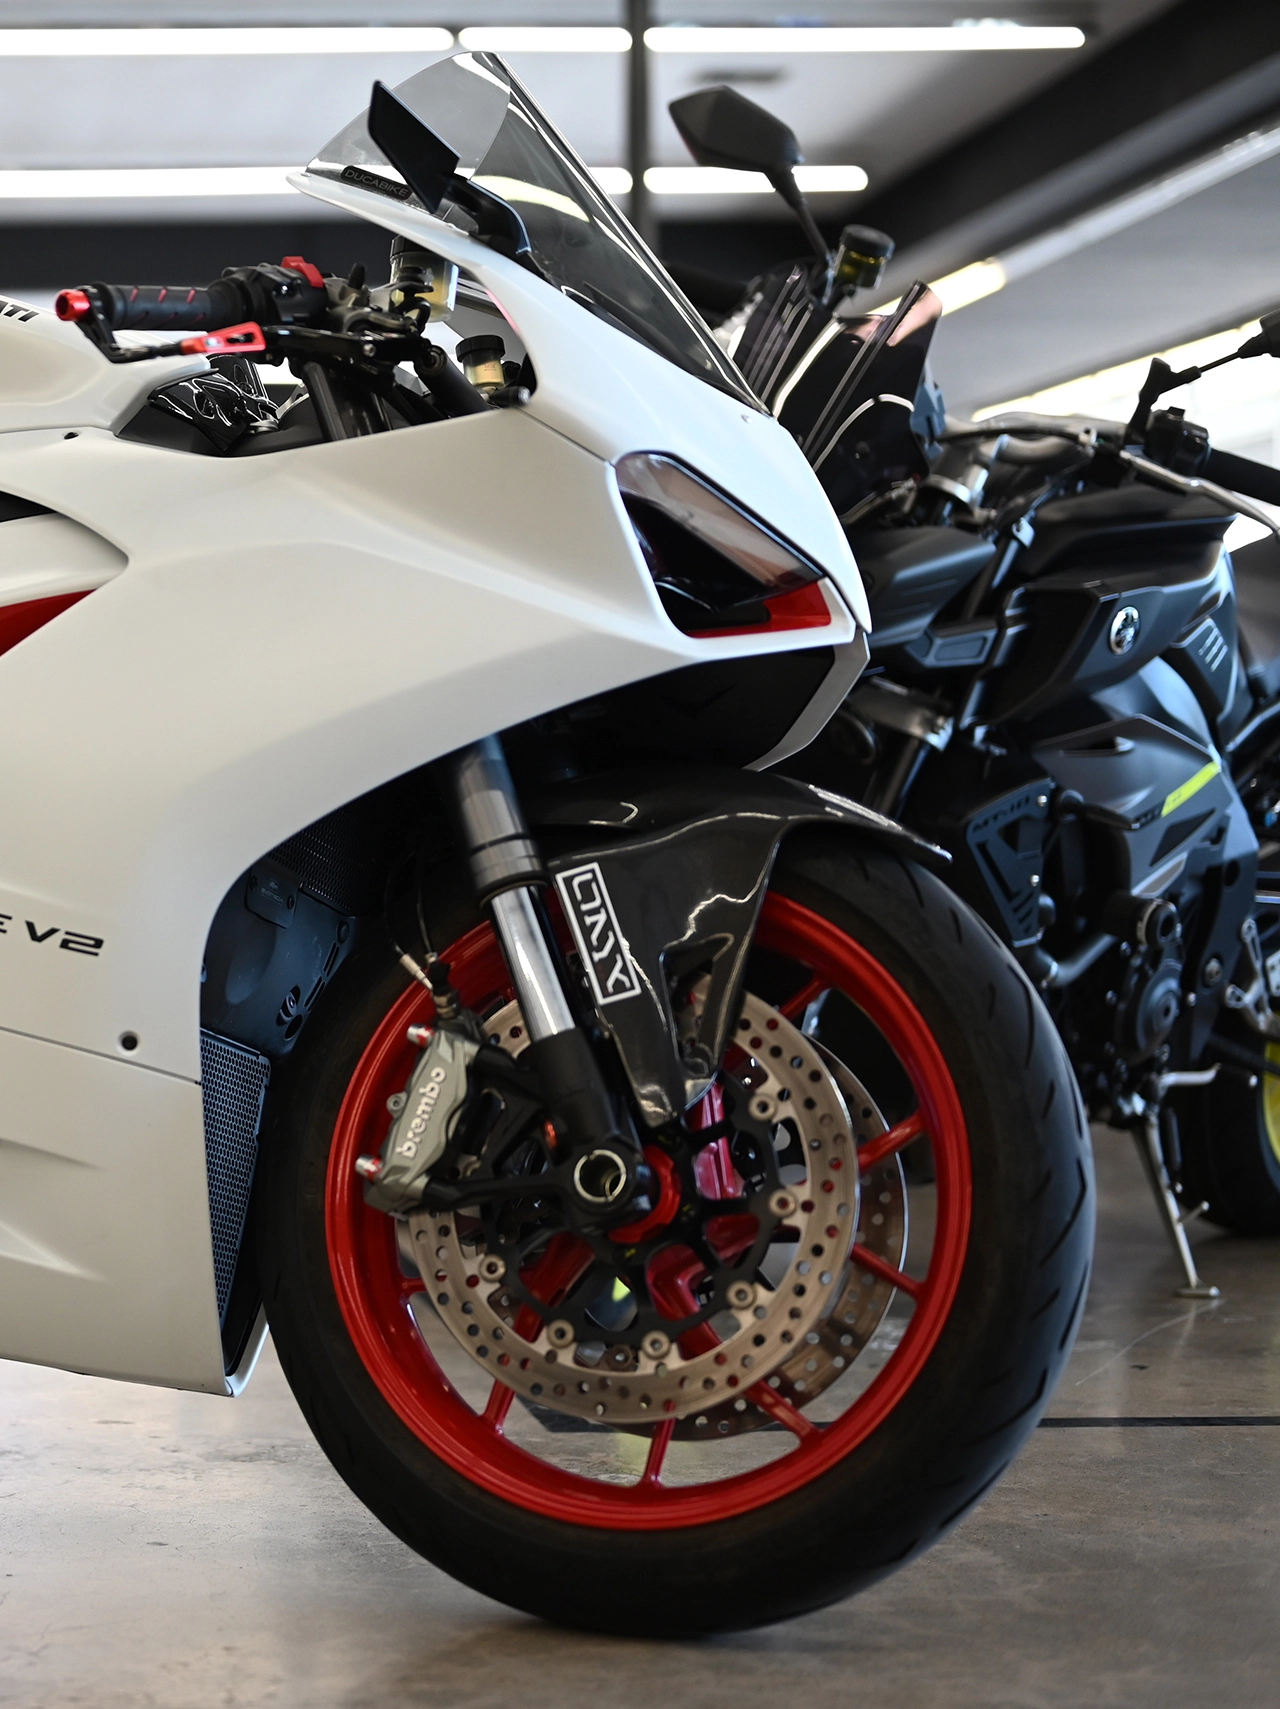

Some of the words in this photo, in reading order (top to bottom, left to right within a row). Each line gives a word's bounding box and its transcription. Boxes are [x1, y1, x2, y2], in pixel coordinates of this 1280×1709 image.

[344, 169, 410, 197] DUCABIKE
[24, 920, 105, 957] V2
[571, 871, 632, 994] ONYX
[395, 1066, 447, 1158] brembo
